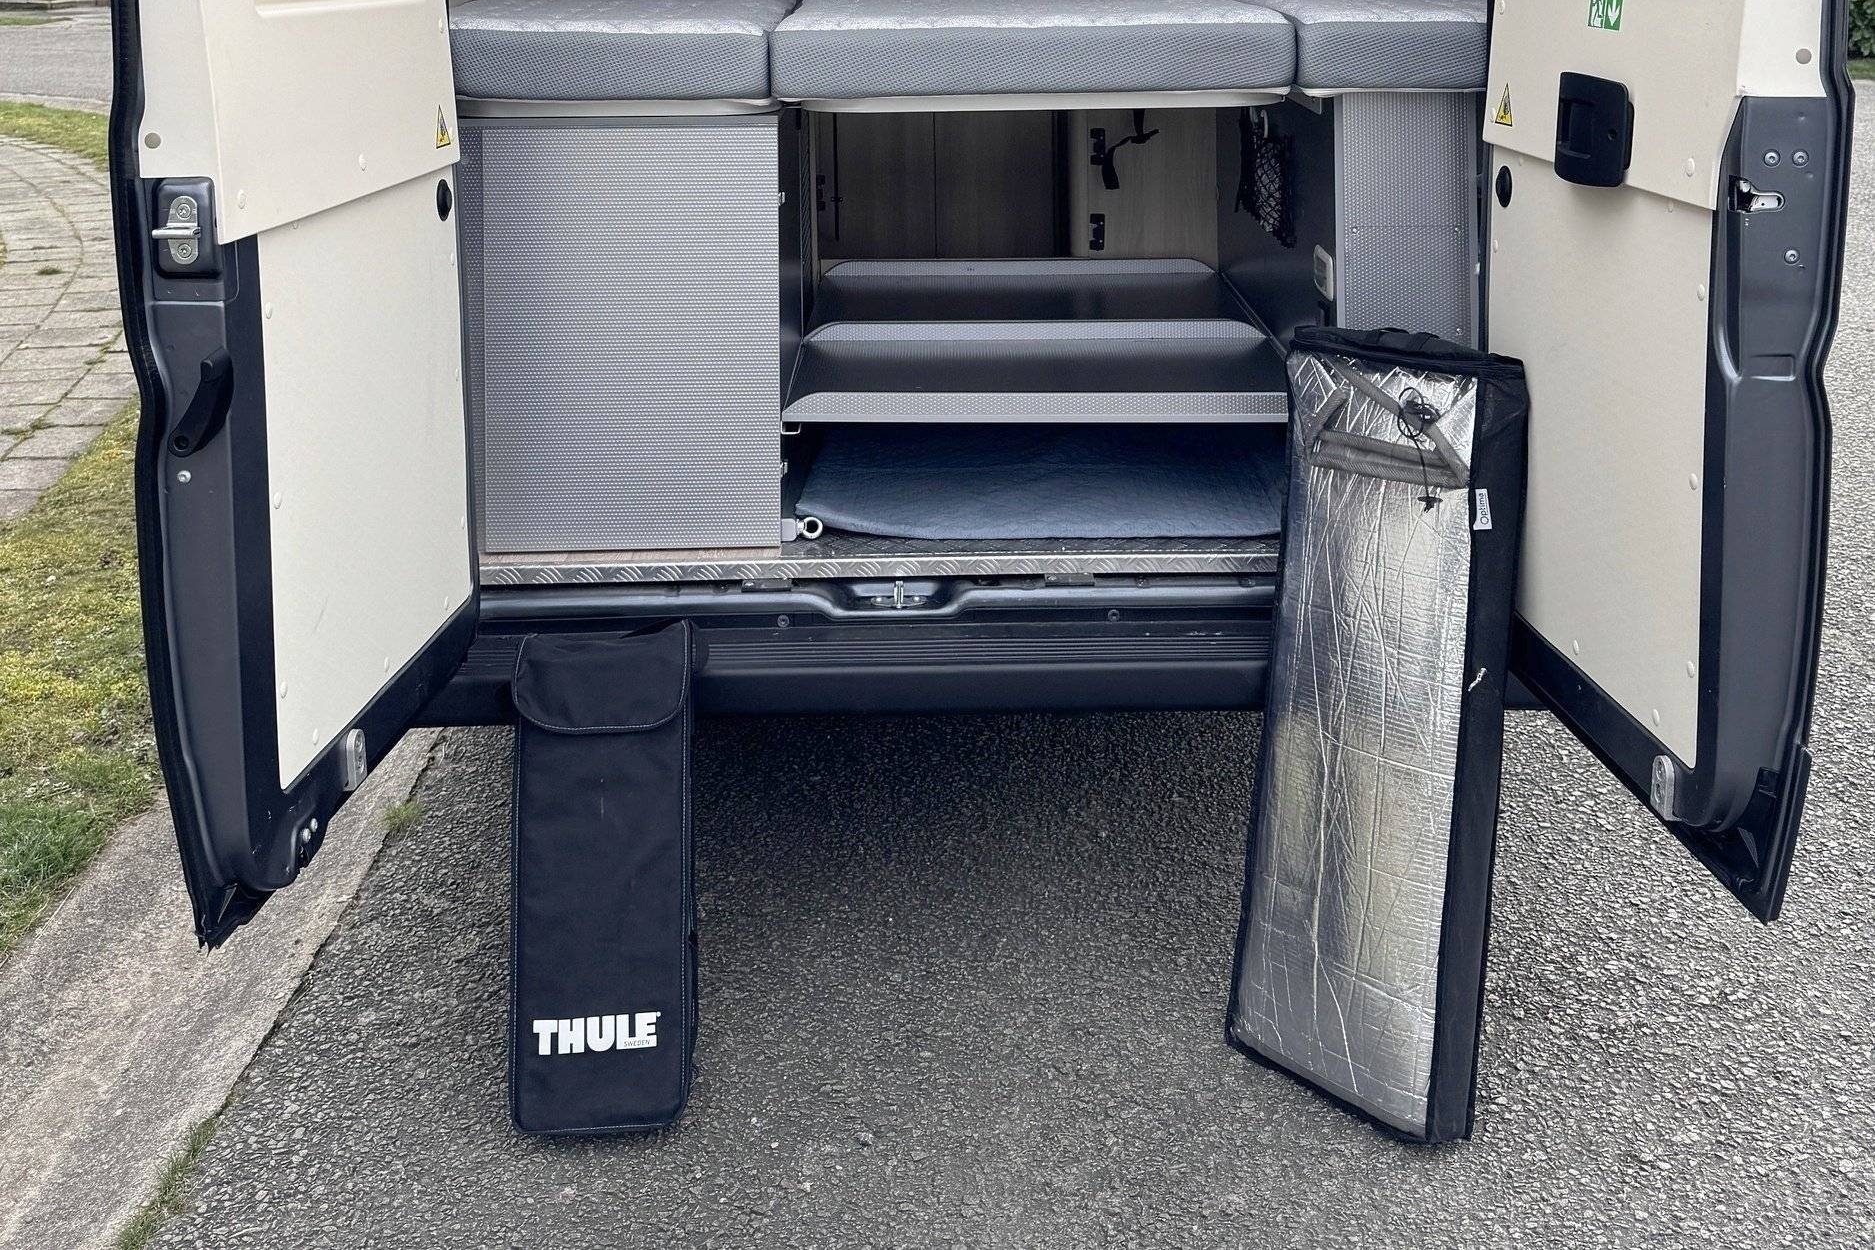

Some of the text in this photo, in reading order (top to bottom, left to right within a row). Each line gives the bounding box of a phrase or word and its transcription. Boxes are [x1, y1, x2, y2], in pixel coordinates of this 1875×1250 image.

[1479, 493, 1489, 525] Optima
[533, 1012, 659, 1056] THULE
[623, 1039, 650, 1048] SWEDEN
